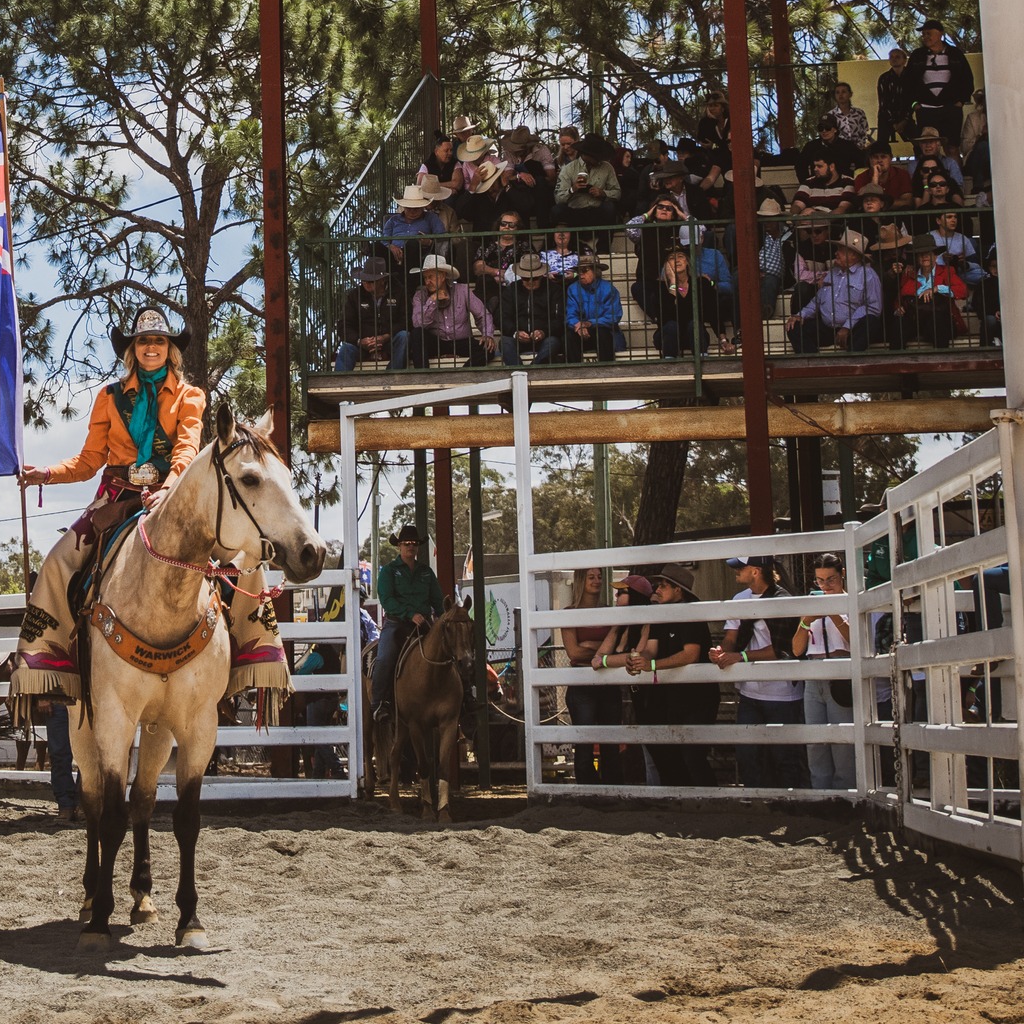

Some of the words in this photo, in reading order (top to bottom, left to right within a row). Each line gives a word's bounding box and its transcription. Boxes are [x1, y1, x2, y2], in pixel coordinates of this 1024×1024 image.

[129, 655, 153, 668] RODEO
[175, 649, 196, 665] QUEEN
[135, 642, 191, 660] WARWICK
